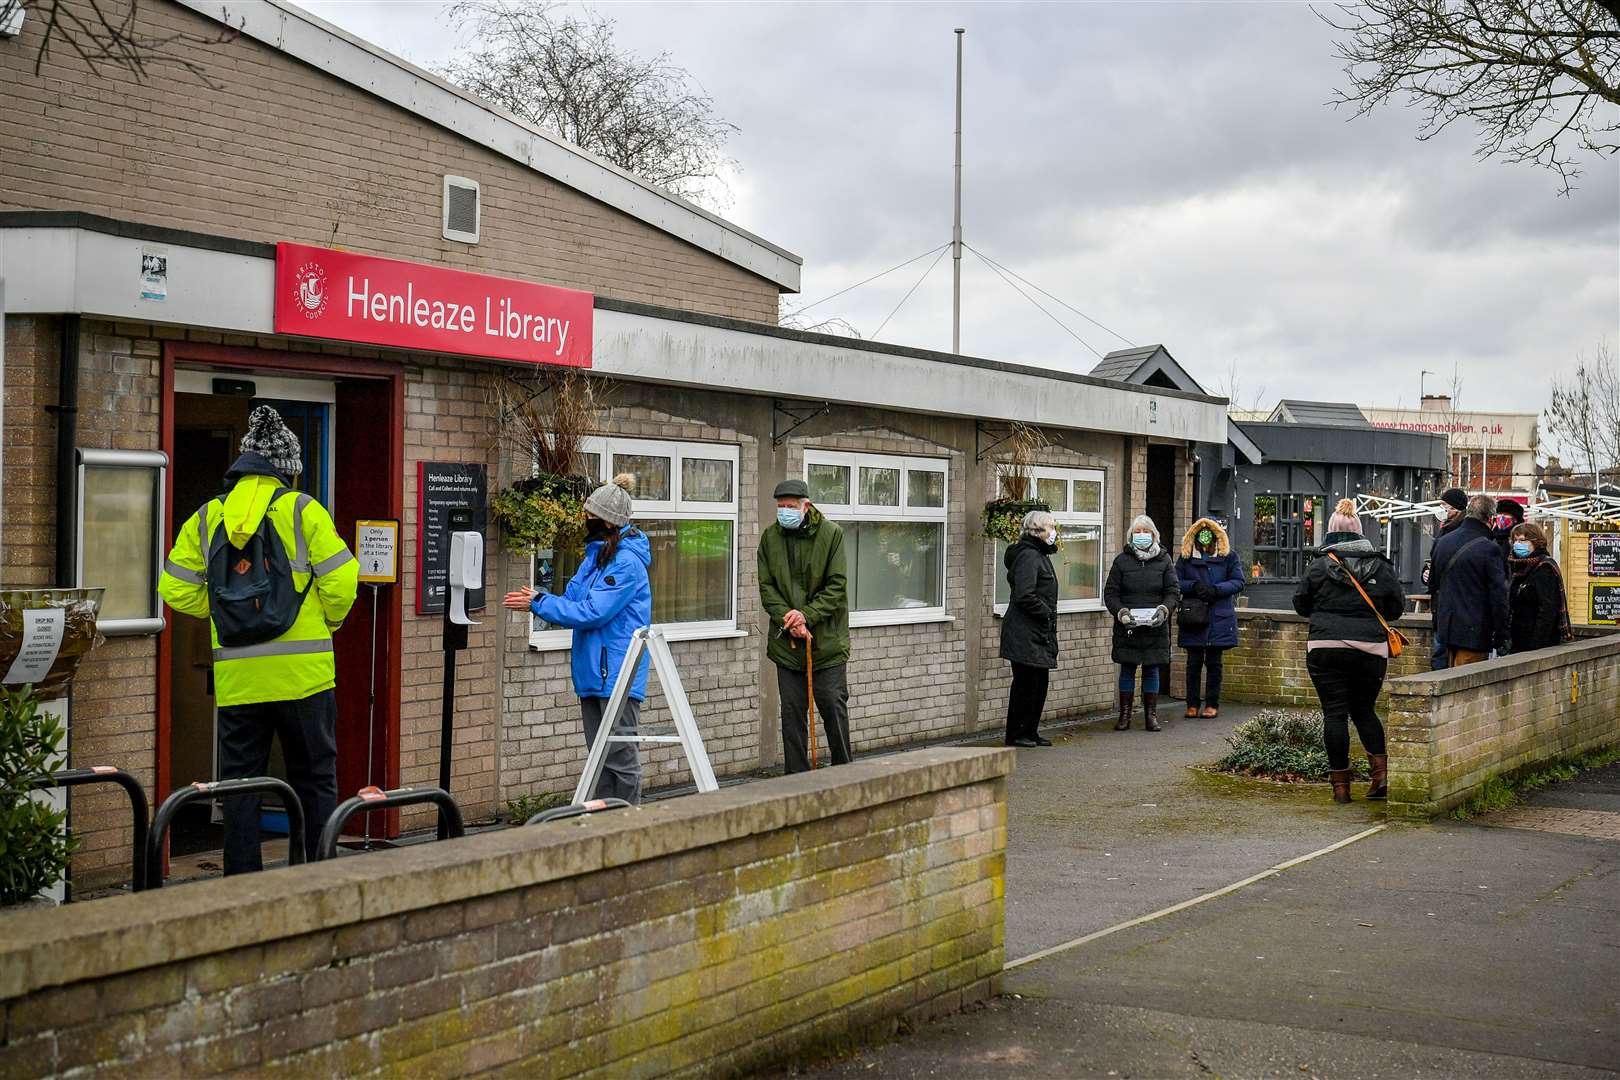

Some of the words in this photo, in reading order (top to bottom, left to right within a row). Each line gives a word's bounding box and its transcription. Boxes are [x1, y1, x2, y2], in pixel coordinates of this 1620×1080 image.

[296, 262, 328, 283] BRISTOL
[293, 290, 304, 312] CITY
[305, 295, 329, 320] COUNCIL
[347, 276, 475, 333] Henleaze
[485, 296, 570, 355] Library
[428, 473, 453, 483] Henleaze
[454, 474, 472, 486] Library
